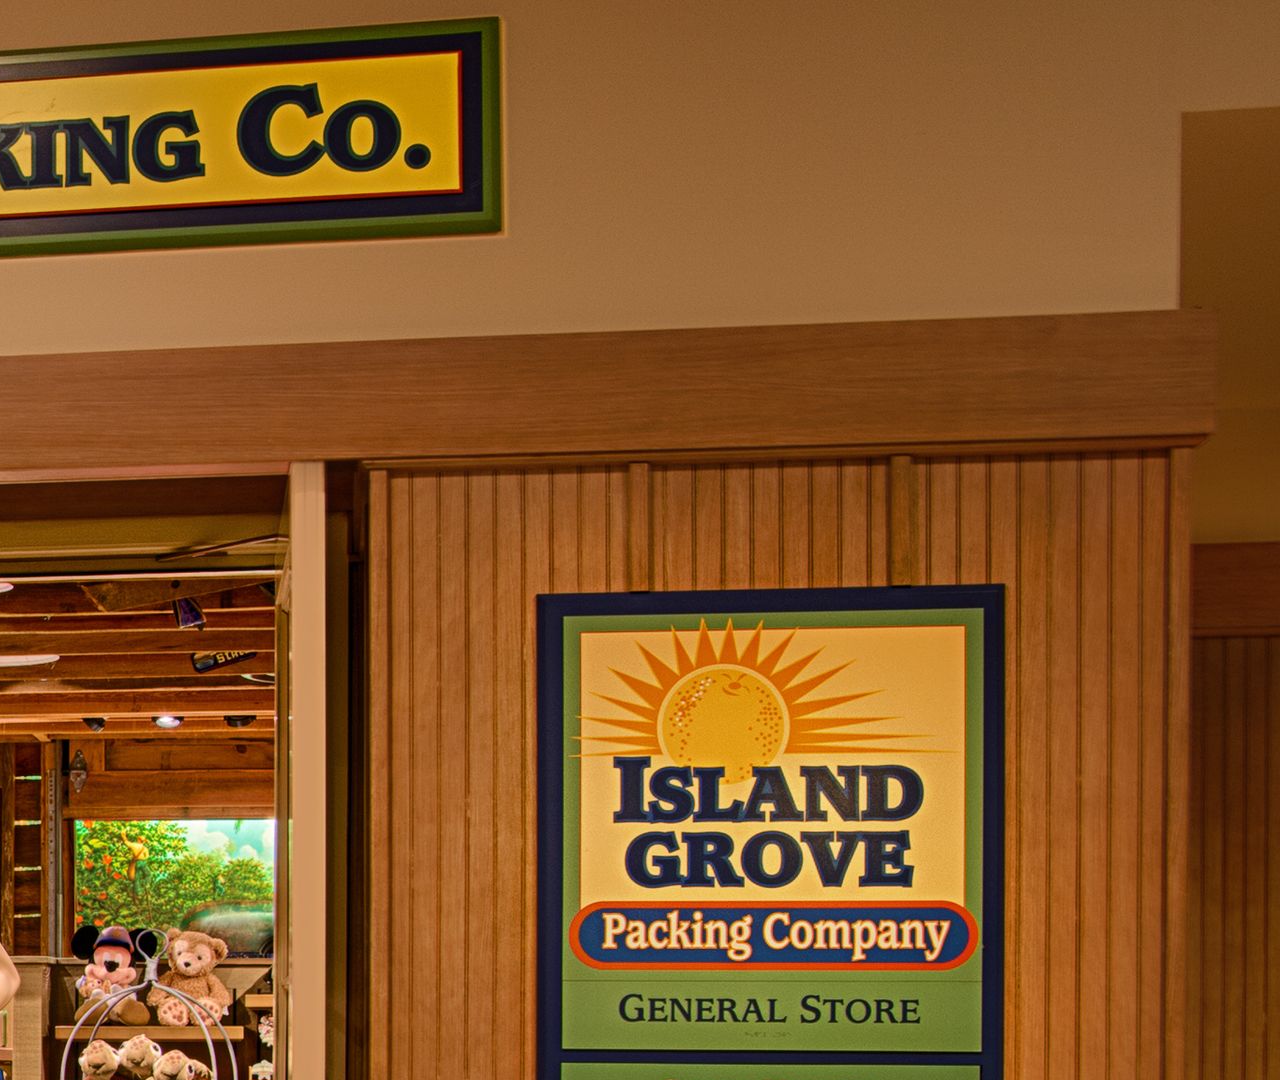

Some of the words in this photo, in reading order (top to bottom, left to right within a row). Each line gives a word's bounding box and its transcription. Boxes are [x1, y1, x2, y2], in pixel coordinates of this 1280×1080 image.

[236, 80, 433, 178] CO.
[613, 756, 924, 824] ISLAND
[625, 829, 915, 889] GROVE
[602, 911, 752, 961] Packing
[764, 913, 951, 961] Company
[618, 993, 788, 1024] GENERAL
[800, 994, 921, 1025] STORE
